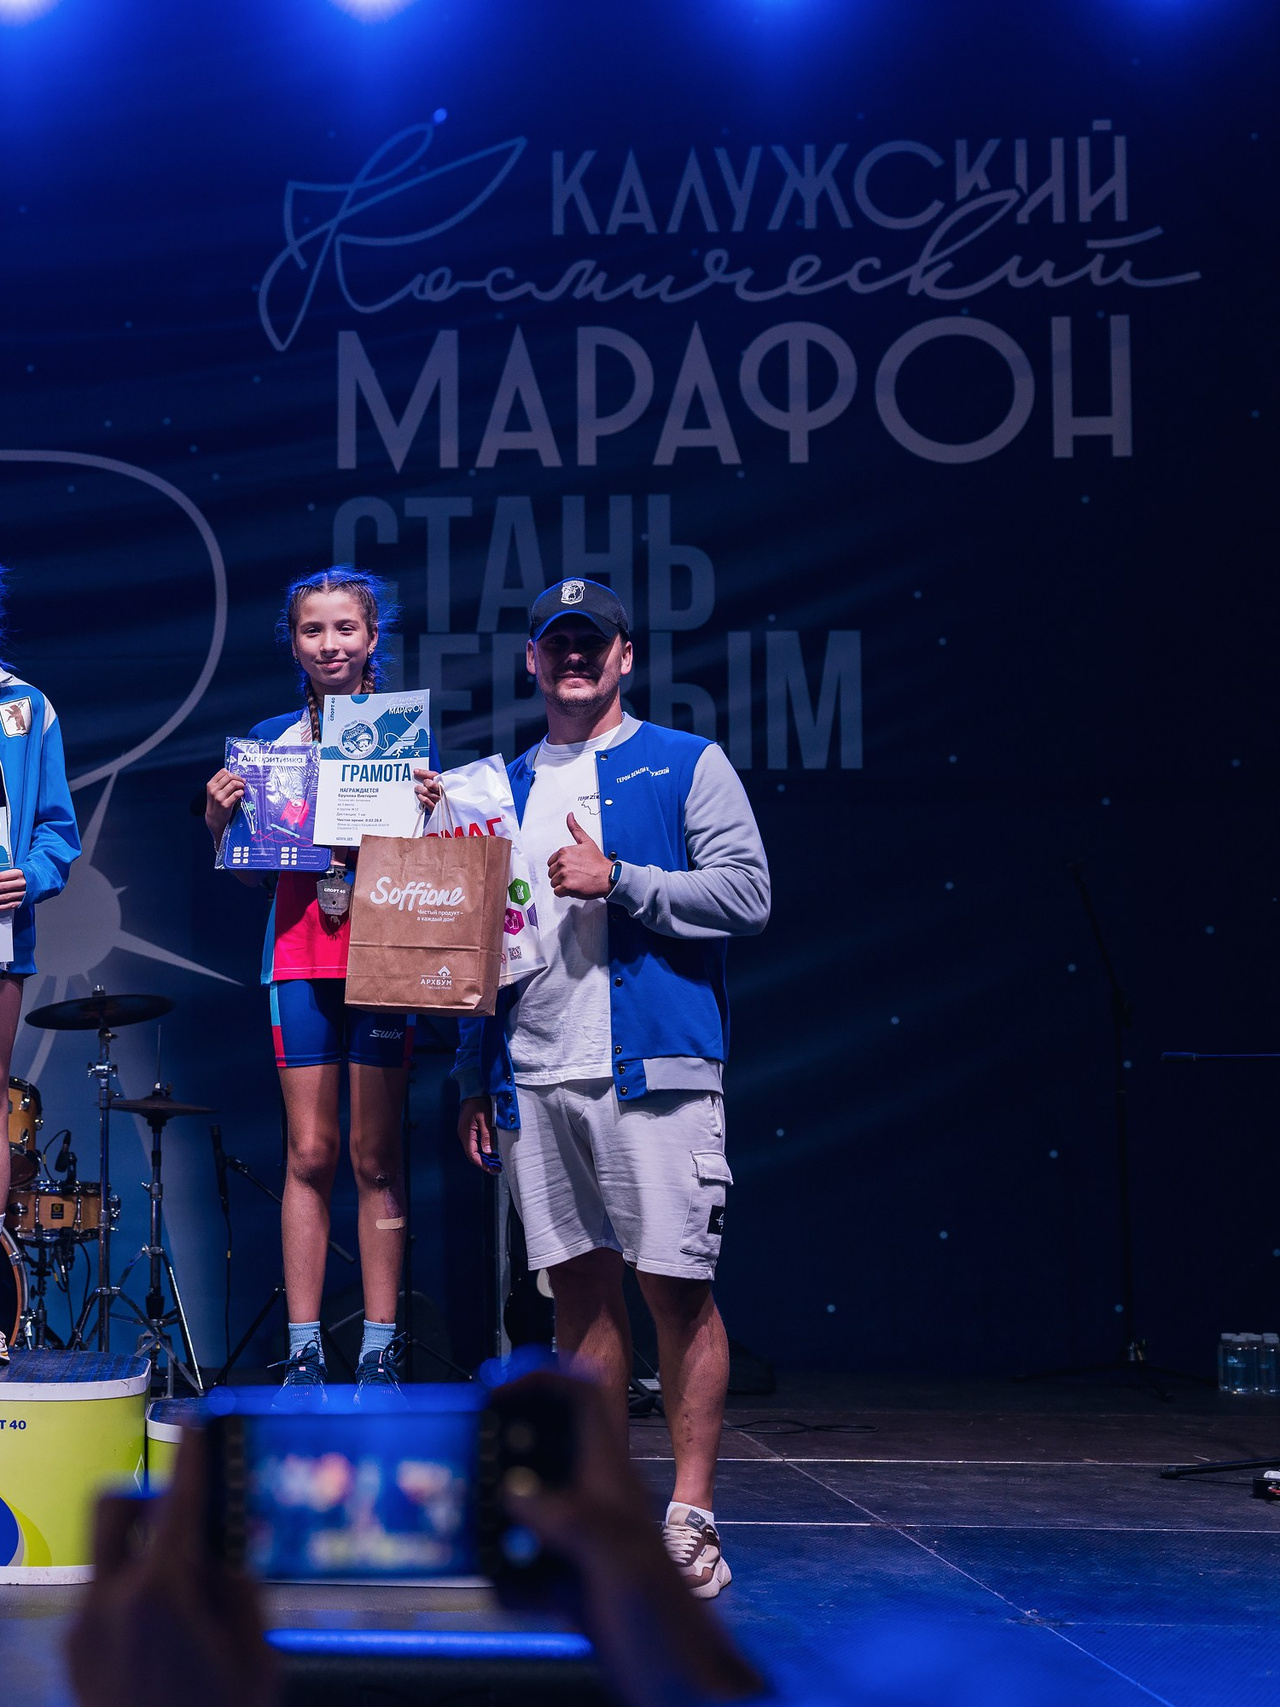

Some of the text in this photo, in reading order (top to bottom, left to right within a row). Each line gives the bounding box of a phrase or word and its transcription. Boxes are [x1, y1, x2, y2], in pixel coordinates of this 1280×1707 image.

[551, 118, 1128, 236] КАЛУЖСКИЙ
[335, 313, 1134, 472] МАРАФОН
[333, 494, 717, 634] СТАНЬ
[394, 629, 864, 770] ЕРЫМ
[342, 763, 412, 782] ГРАМОТА
[370, 876, 465, 911] Soffione
[9, 1420, 27, 1430] 40
